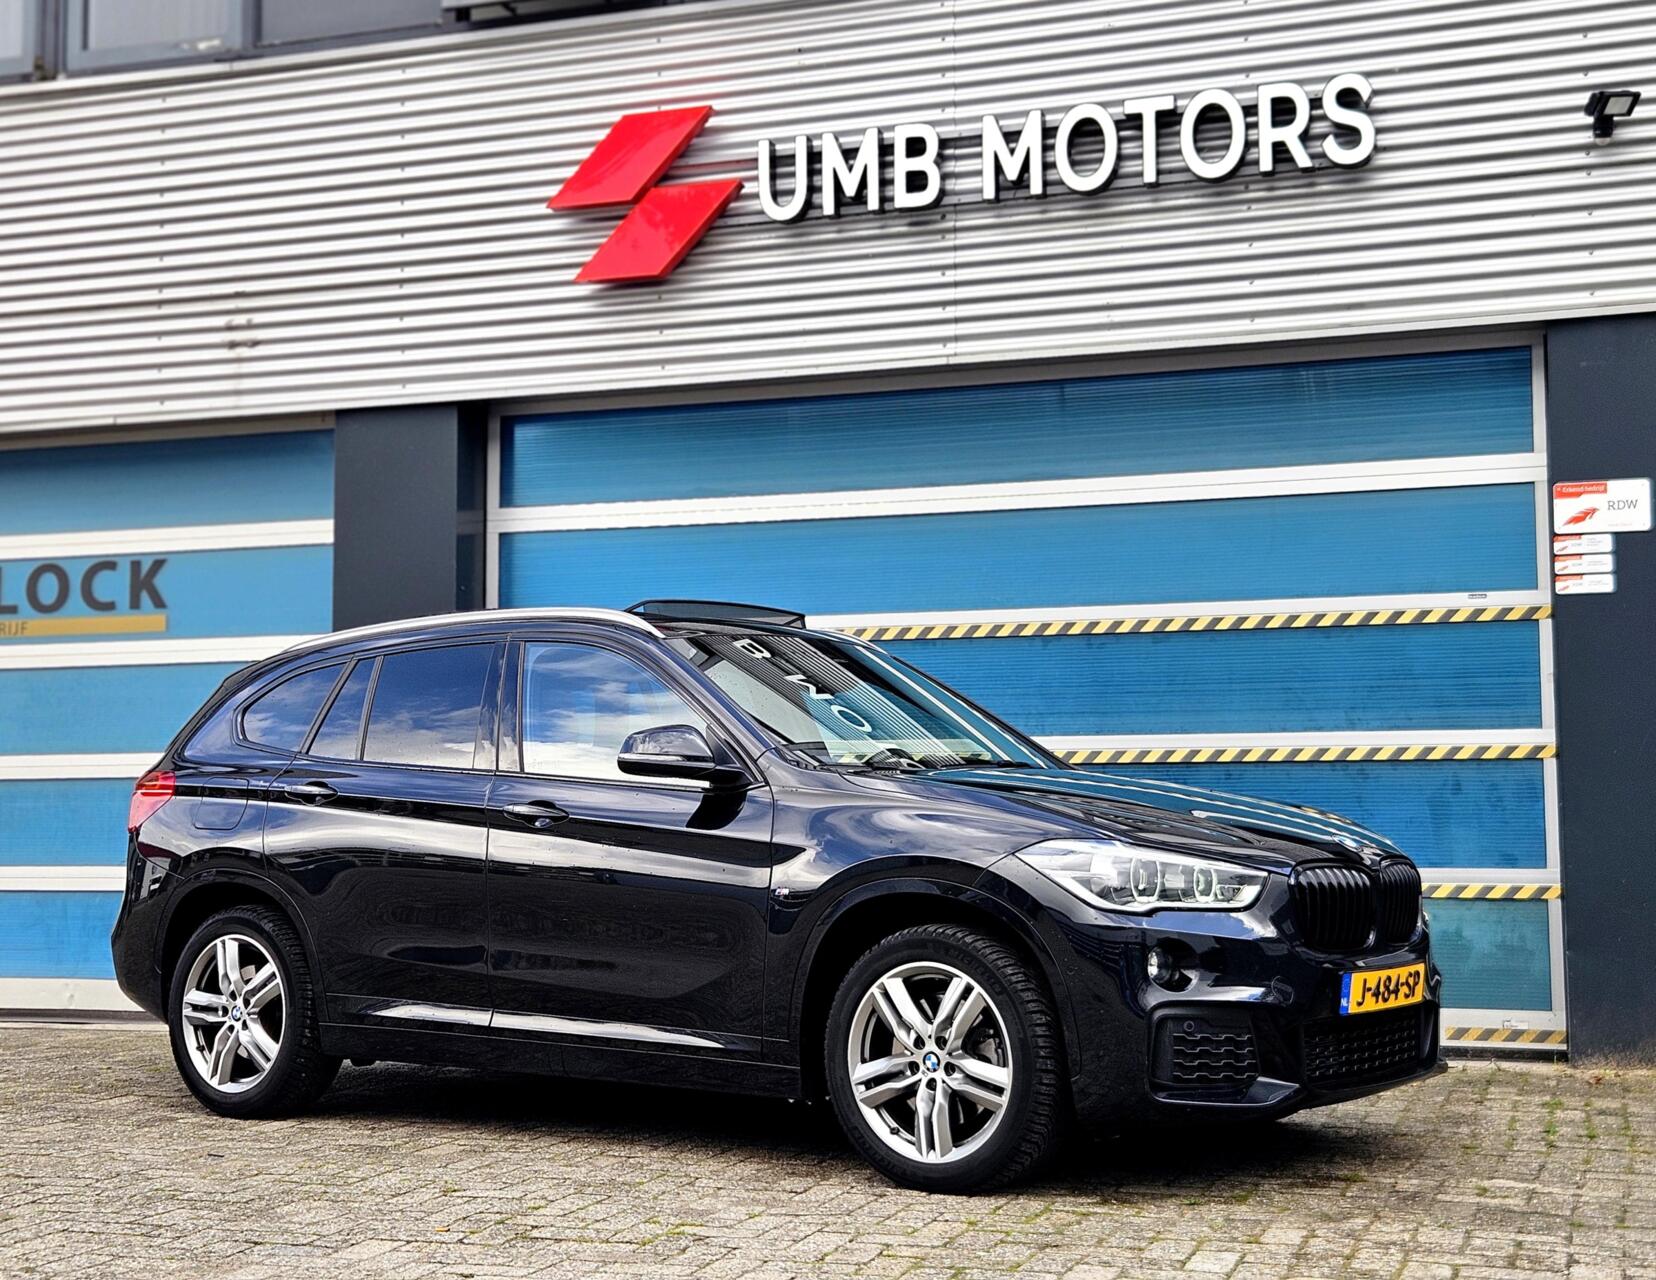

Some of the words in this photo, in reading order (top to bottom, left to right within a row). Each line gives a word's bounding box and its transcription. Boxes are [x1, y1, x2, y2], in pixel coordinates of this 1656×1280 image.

[757, 123, 942, 224] UMB
[981, 72, 1376, 200] MOTORS
[1607, 500, 1638, 510] RDW
[1356, 970, 1420, 1007] J-484-SP
[1341, 998, 1349, 1007] NL
